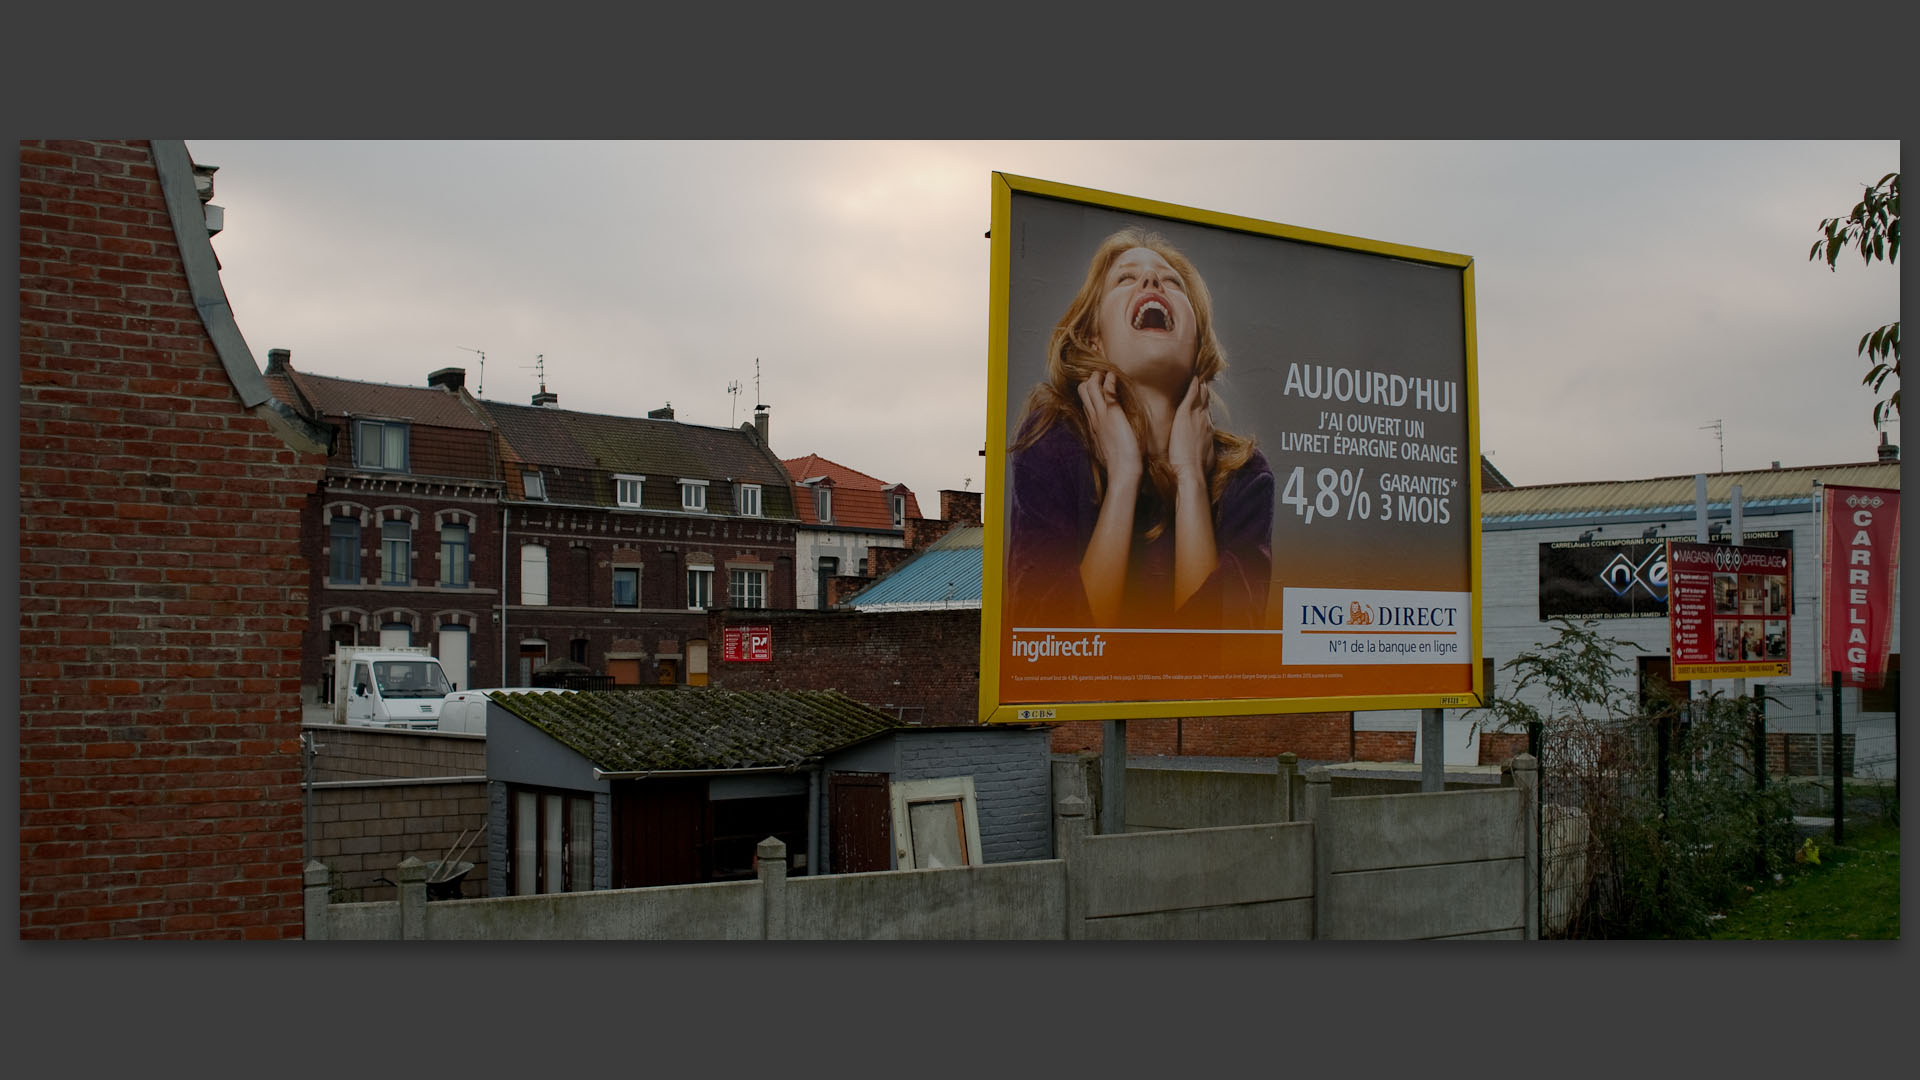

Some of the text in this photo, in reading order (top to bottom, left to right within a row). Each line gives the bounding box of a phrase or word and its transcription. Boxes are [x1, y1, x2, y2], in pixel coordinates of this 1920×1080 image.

[1283, 362, 1457, 414] AUJOURD'HUI
[1318, 411, 1425, 439] J'AI OUVERT UN
[1281, 431, 1458, 465] LIVRET ÉPARGNE ORANGE
[1282, 466, 1371, 525] 4,8%
[1380, 494, 1450, 525] 3 MOIS
[1646, 537, 1664, 545] POUR
[1679, 549, 1714, 564] MAGASIN
[1847, 510, 1873, 683] CARRELAGE
[1301, 605, 1457, 627] ING DIRECT
[1012, 634, 1107, 663] ingdirect.fr
[1329, 640, 1458, 656] N°1 de la banque en ligne
